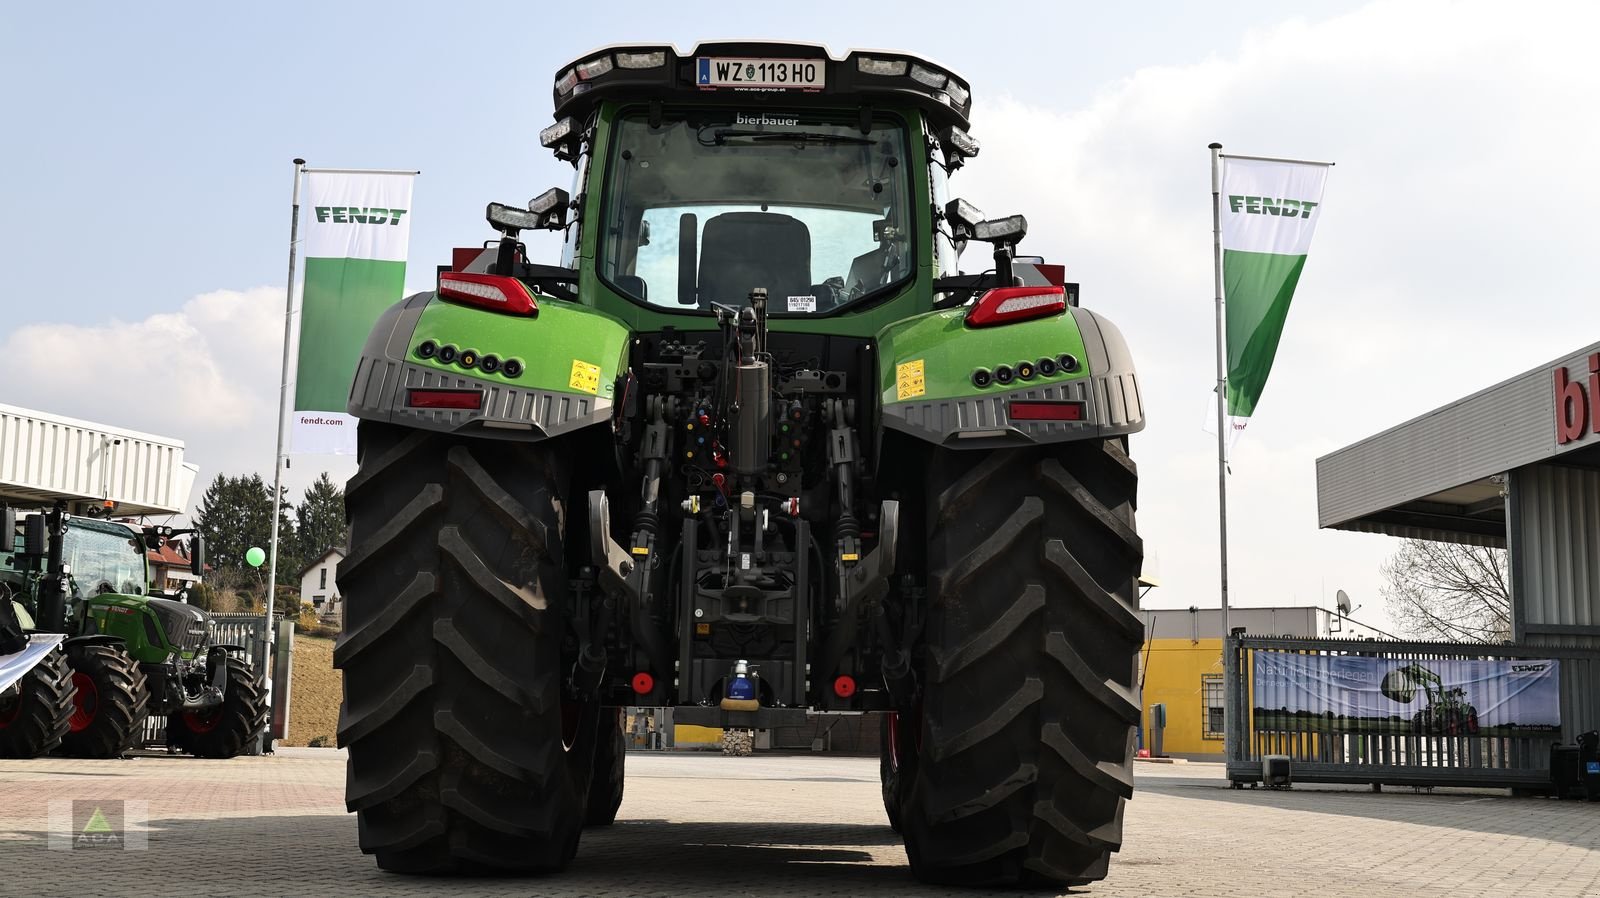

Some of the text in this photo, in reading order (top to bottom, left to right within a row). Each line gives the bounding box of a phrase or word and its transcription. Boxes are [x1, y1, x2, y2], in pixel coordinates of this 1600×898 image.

[716, 62, 815, 82] WZ 113 HO
[736, 112, 799, 126] bierbauer
[315, 206, 407, 226] FENDT
[1228, 195, 1318, 219] FENDT
[300, 416, 343, 426] fendt.com
